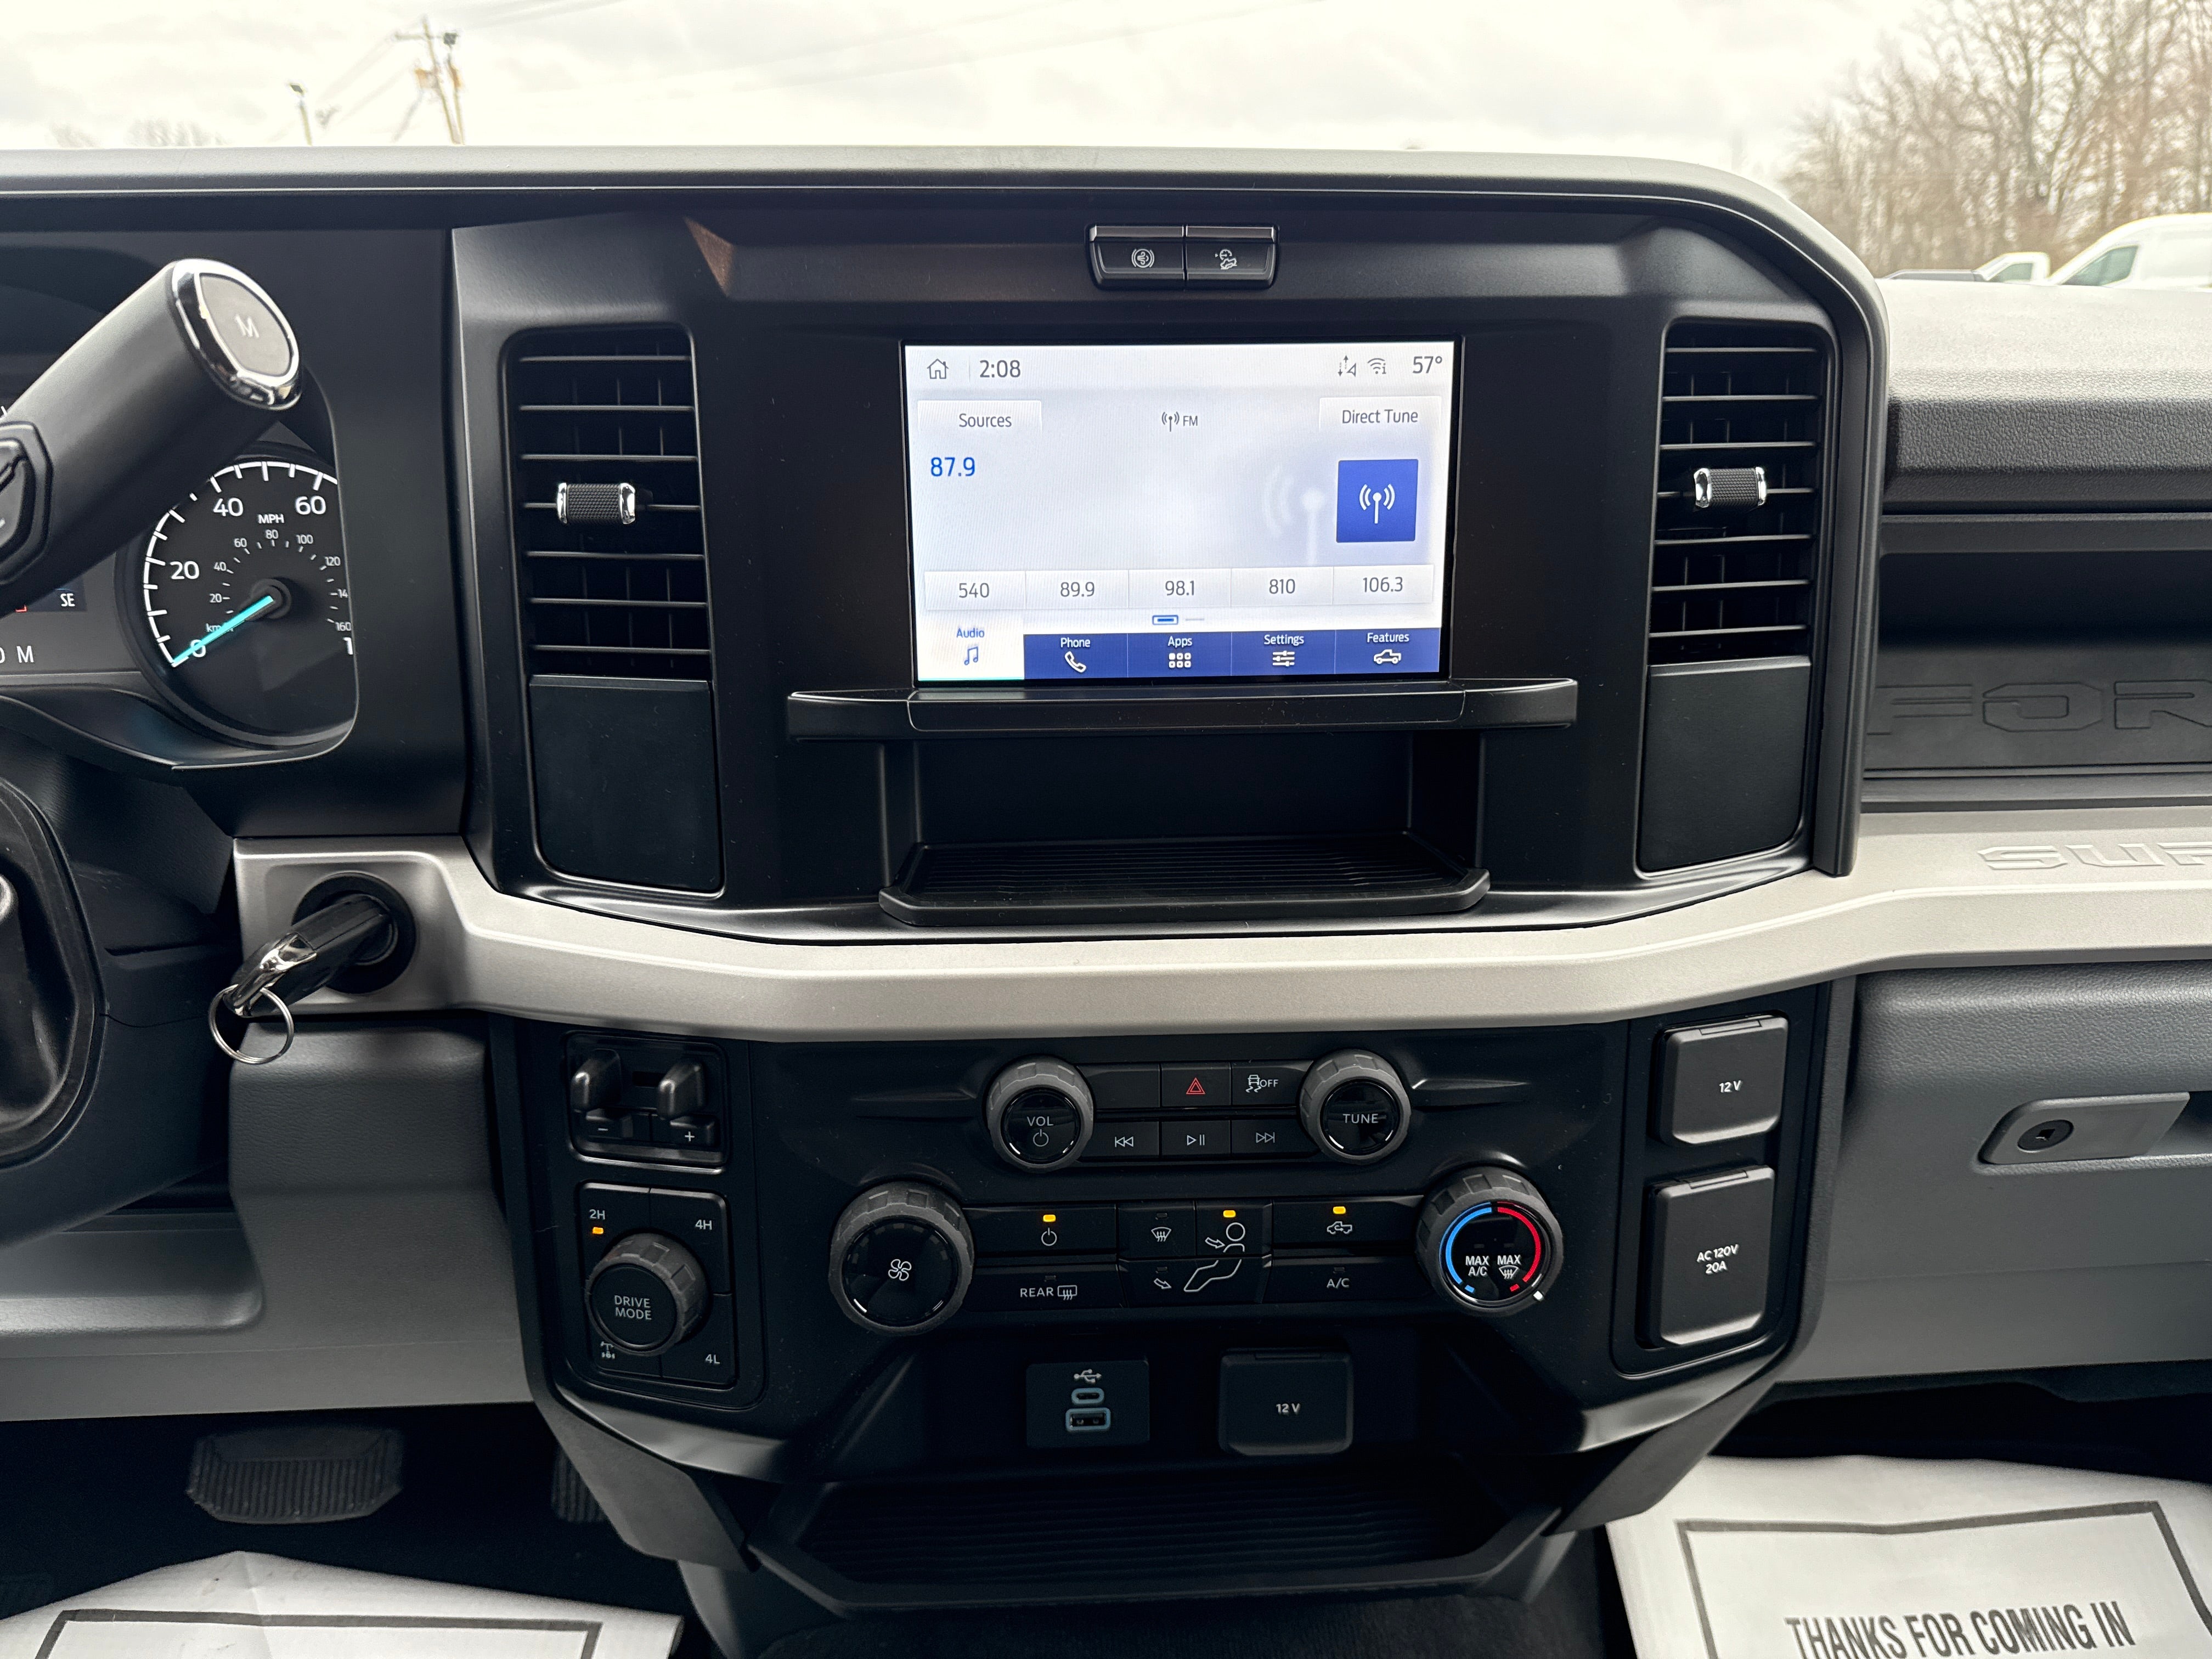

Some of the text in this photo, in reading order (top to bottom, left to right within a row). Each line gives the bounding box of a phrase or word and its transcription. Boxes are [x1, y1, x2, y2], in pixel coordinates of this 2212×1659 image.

[235, 313, 259, 338] M
[979, 359, 1022, 379] 2:08
[1412, 356, 1443, 374] 57°
[958, 413, 1012, 428] Sources
[1183, 415, 1198, 427] FM
[1342, 409, 1419, 424] Direct Tune
[930, 456, 976, 477] 87.9
[213, 498, 244, 516] 40
[295, 495, 326, 515] 60
[258, 514, 285, 524] MPH
[265, 529, 279, 539] 80
[296, 534, 314, 544] 100
[234, 538, 247, 548] 60
[213, 561, 227, 571] 40
[324, 556, 341, 566] 120
[170, 560, 200, 580] 20
[958, 583, 990, 599] 540
[1060, 582, 1095, 597] 89.9
[1165, 580, 1195, 596] 98.1
[1269, 579, 1296, 595] 810
[1363, 577, 1403, 593] 106.3
[60, 593, 76, 607] SE
[209, 593, 223, 603] 20
[335, 621, 351, 631] 160
[956, 628, 985, 639] Audio
[1367, 633, 1410, 644] Features
[1060, 637, 1091, 648] Phone
[1167, 636, 1193, 649] Apps
[1263, 634, 1305, 646] Settings
[16, 645, 34, 663] M
[1260, 1079, 1279, 1087] OFF
[1719, 1080, 1742, 1093] 12 V
[1026, 1116, 1054, 1127] VOL
[1342, 1113, 1379, 1124] TUNE
[589, 1209, 606, 1220] 2H
[695, 1220, 713, 1231] 4H
[1497, 1254, 1522, 1265] MAX
[1696, 1244, 1739, 1263] AC 120V
[1465, 1255, 1489, 1266] MAX
[1468, 1266, 1488, 1277] A/C
[1705, 1260, 1728, 1274] 20A
[1327, 1278, 1350, 1289] A/C
[1020, 1287, 1054, 1298] REAR
[614, 1295, 651, 1308] DRIVE
[615, 1307, 652, 1320] MODE
[705, 1353, 720, 1364] 4L
[1276, 1403, 1300, 1414] 12 V
[1784, 1600, 2136, 1659] THANKS FOR COMING IN
